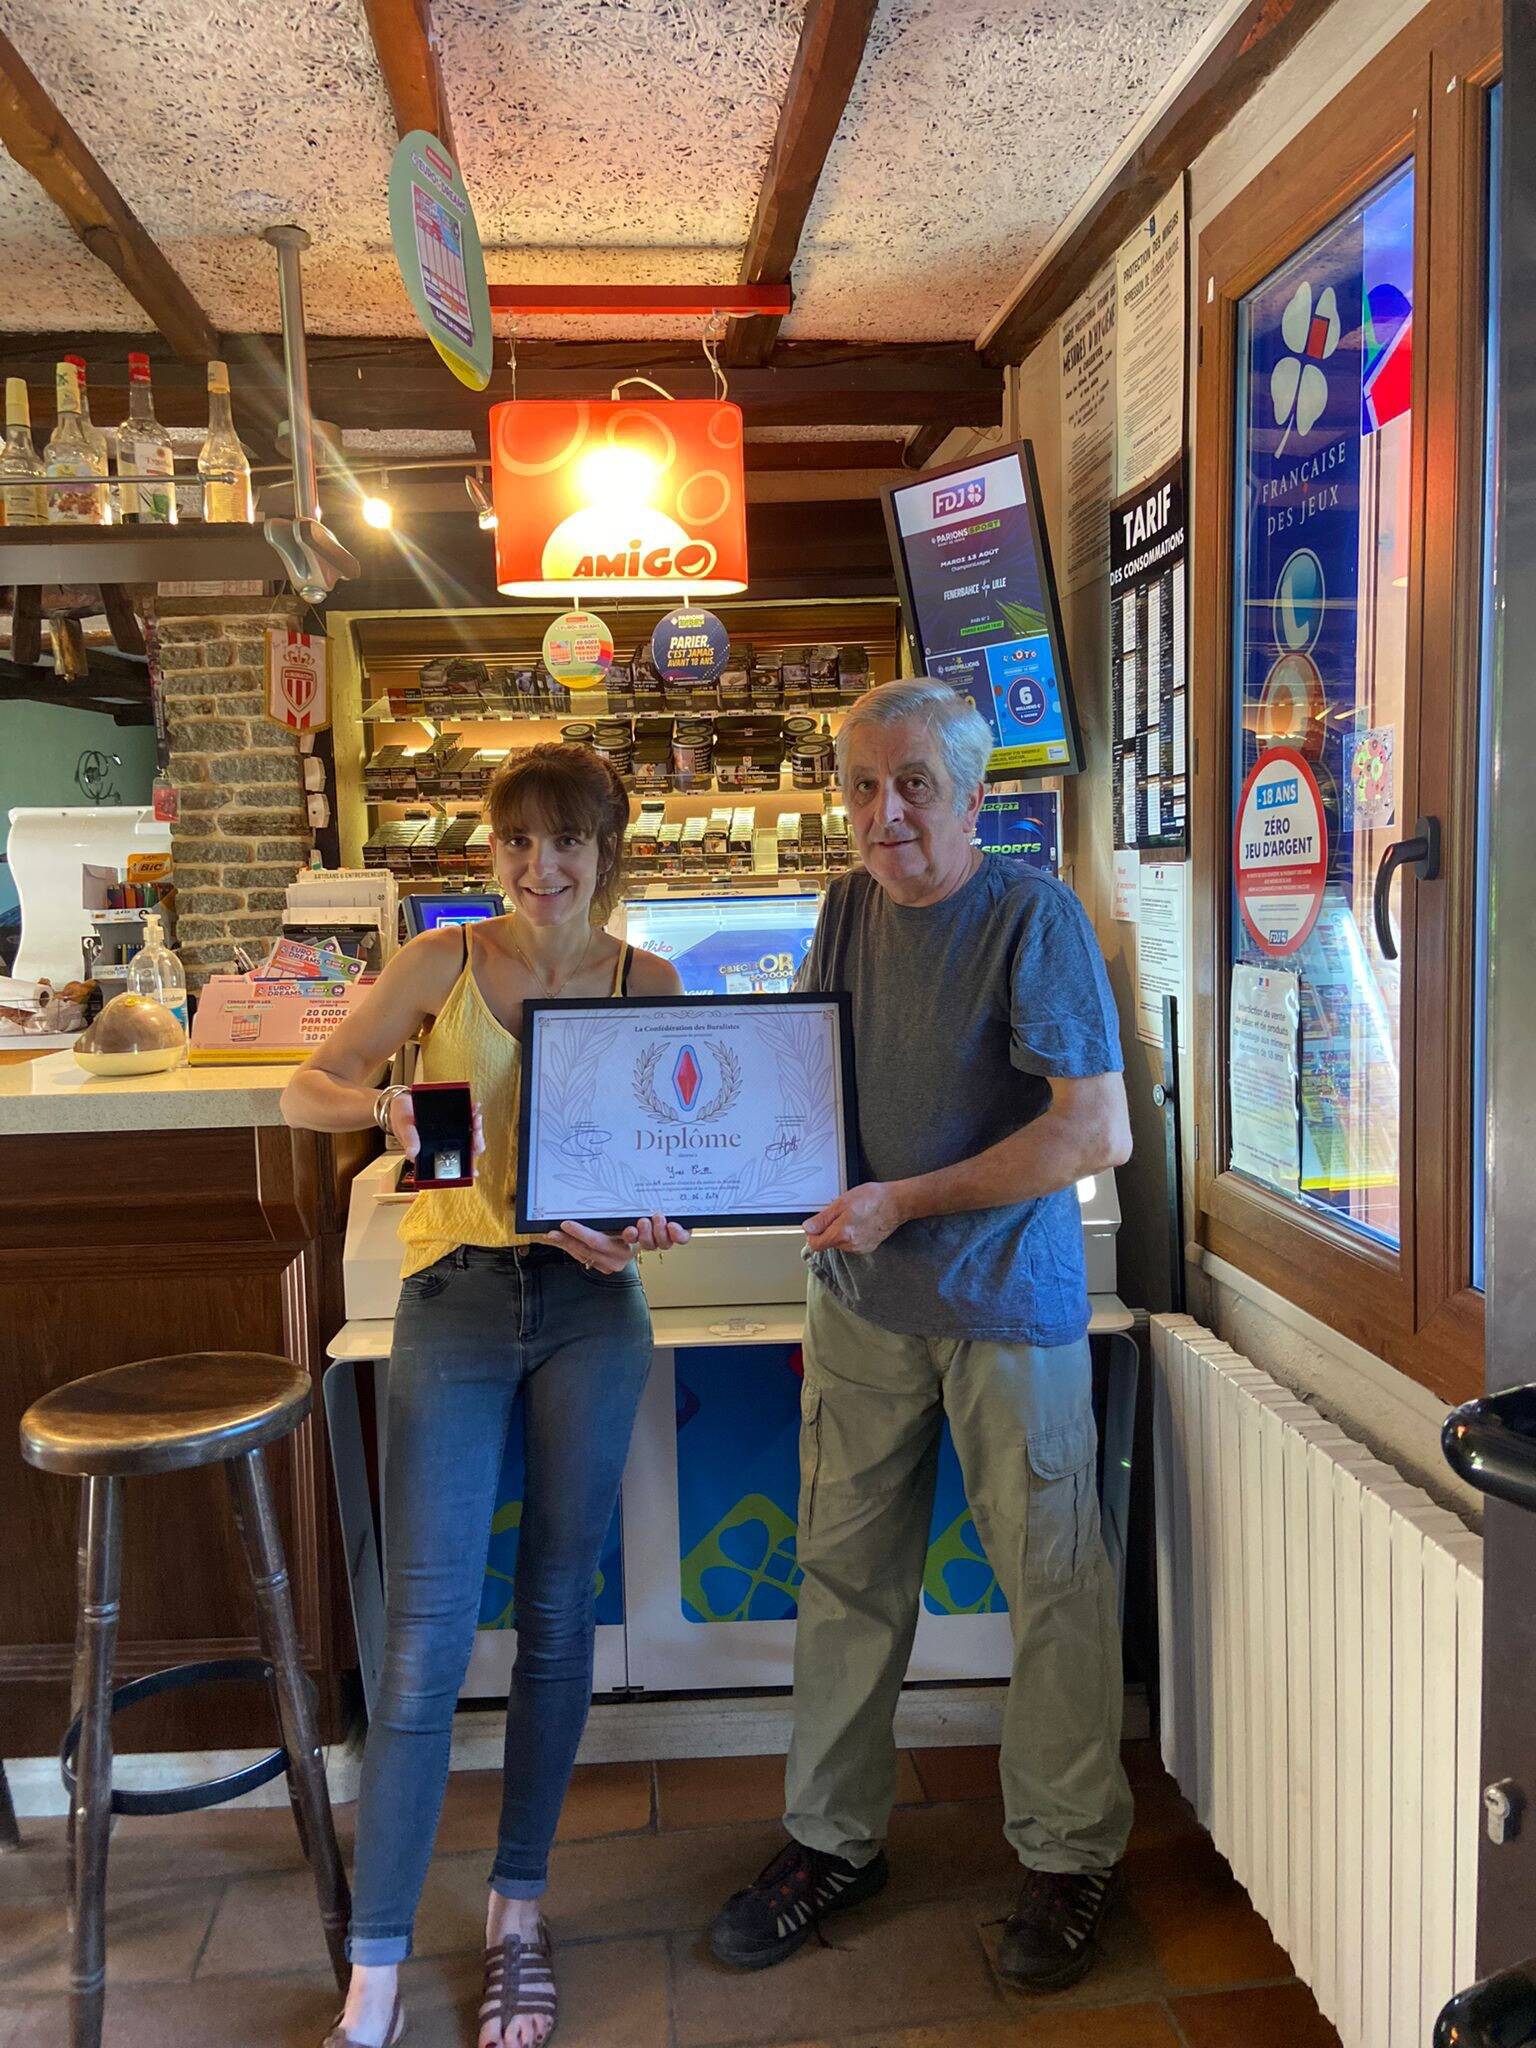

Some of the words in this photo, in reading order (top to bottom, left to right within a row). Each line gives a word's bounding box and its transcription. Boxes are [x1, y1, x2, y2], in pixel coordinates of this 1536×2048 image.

[935, 487, 965, 515] FDJ
[1123, 482, 1171, 551] TARIF
[1267, 506, 1293, 537] DES
[1299, 484, 1339, 525] JEUX
[936, 527, 968, 544] PARIONS
[969, 520, 999, 534] SPORT
[940, 556, 966, 568] MARDI
[1109, 566, 1123, 587] DES
[1123, 526, 1185, 579] CONSOMMATIONS
[991, 577, 1007, 590] LILLE
[669, 634, 710, 650] PARIER,
[667, 649, 686, 659] C'EST
[687, 647, 715, 658] JAMAIS
[667, 658, 690, 668] AVANT
[691, 657, 699, 666] 18
[700, 656, 716, 666] ANS.
[1018, 685, 1034, 705] 6
[1274, 783, 1297, 803] ANS
[1264, 814, 1291, 837] ZÉRO
[981, 842, 1042, 855] SPORTS
[1245, 842, 1261, 860] JEU
[1263, 836, 1313, 858] D'ARGENT
[288, 951, 321, 966] DREAMS
[290, 945, 312, 958] EURO
[759, 952, 795, 973] OR
[267, 990, 303, 998] DREAMS
[306, 1009, 319, 1017] 20
[321, 1009, 348, 1017] 000€
[1271, 1012, 1286, 1022] vente
[301, 1017, 321, 1025] PAR
[644, 1023, 693, 1032] Confédération
[694, 1023, 705, 1031] des
[706, 1023, 740, 1031] Buralistes
[305, 1033, 318, 1041] 30
[635, 1126, 742, 1157] Diplôme
